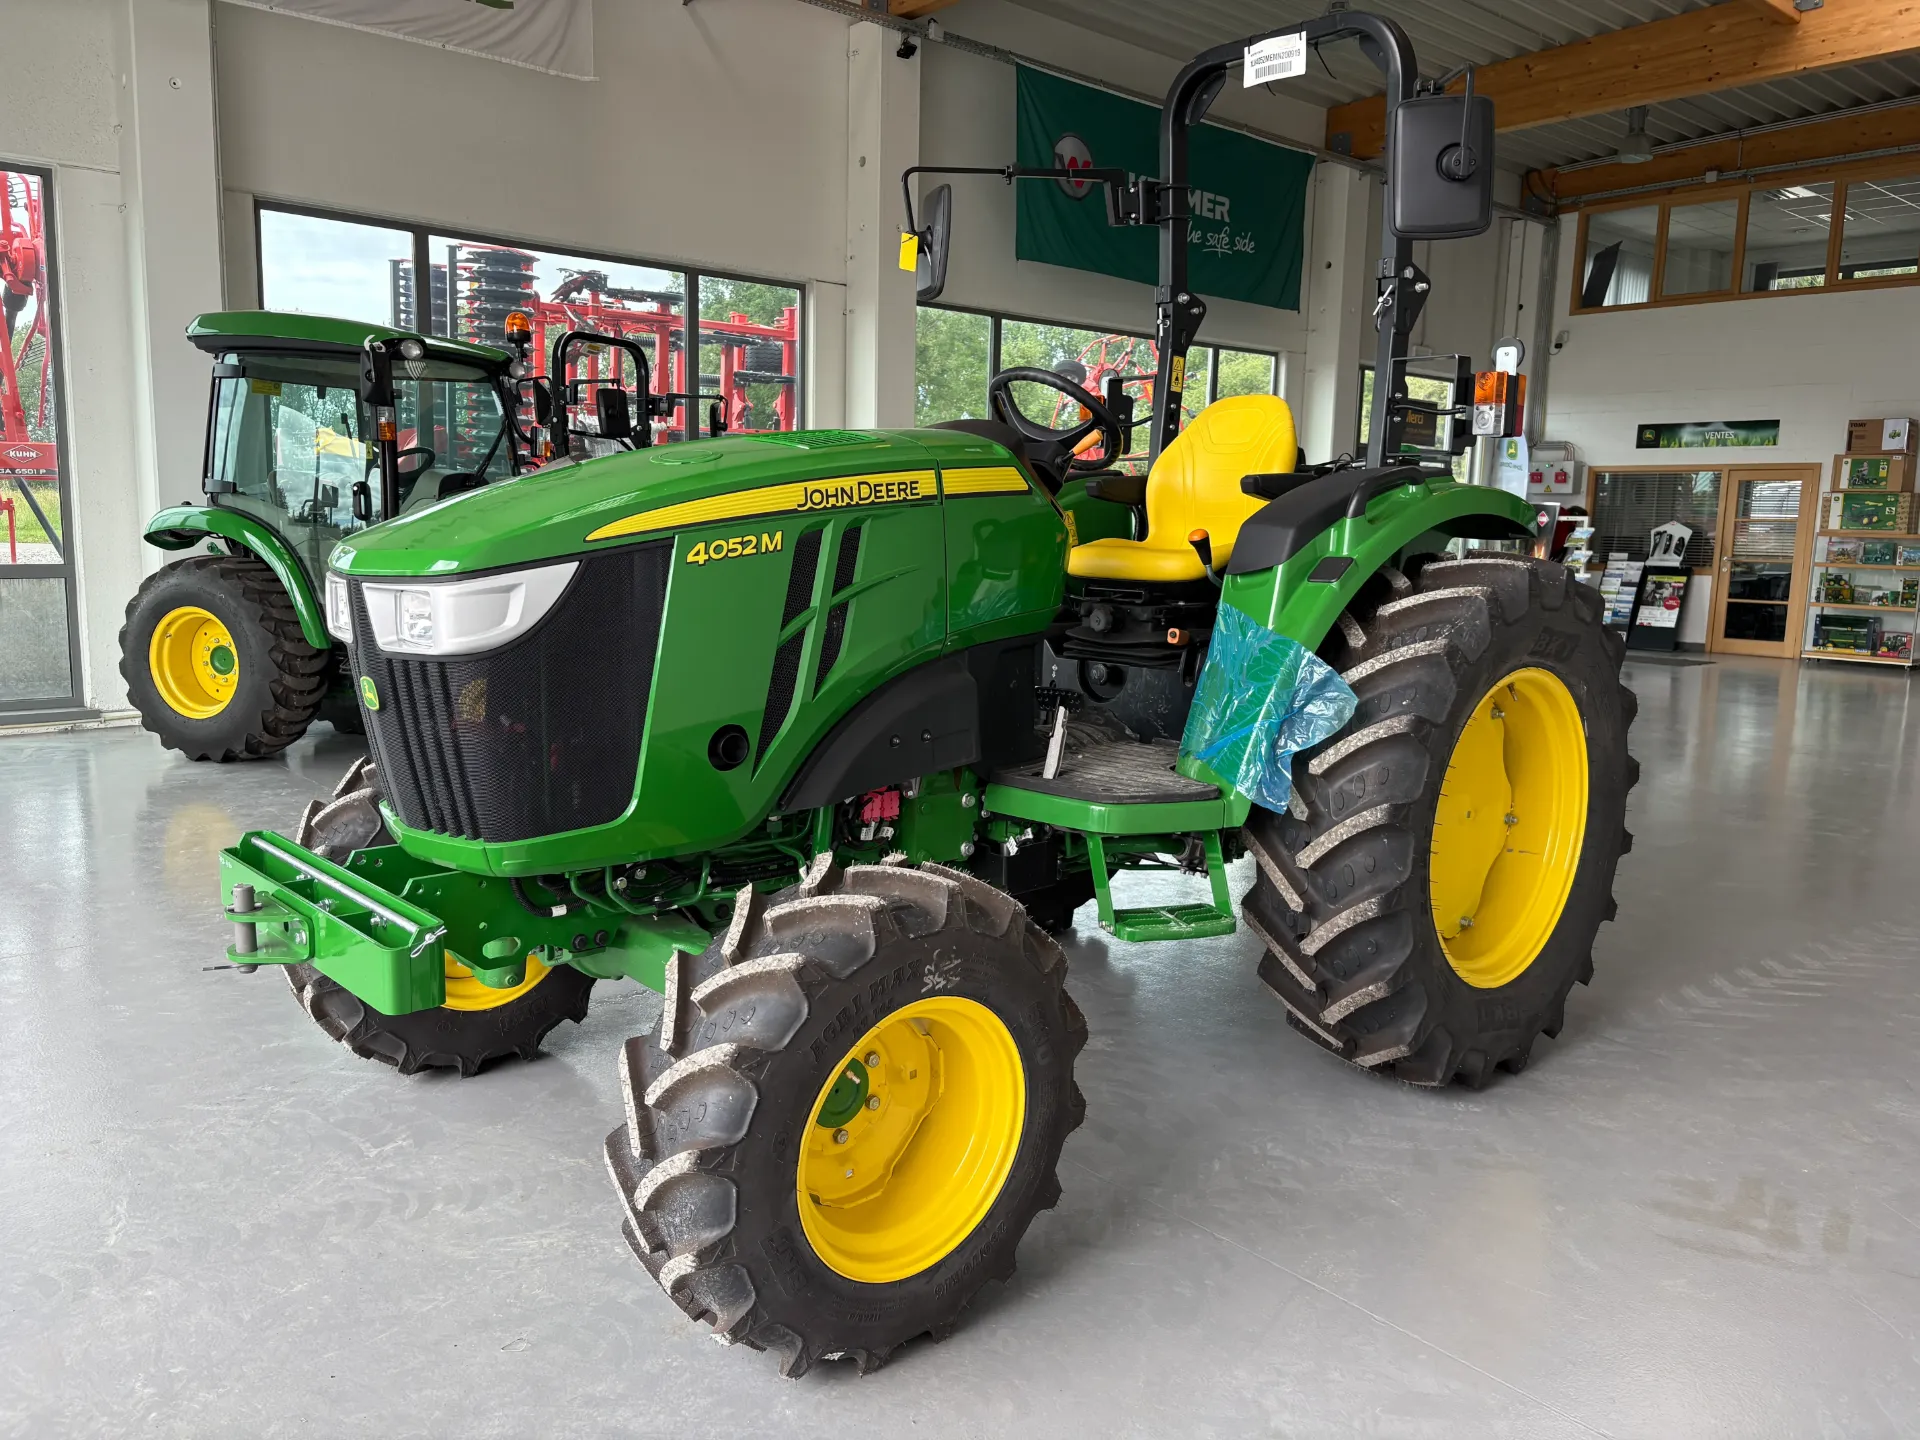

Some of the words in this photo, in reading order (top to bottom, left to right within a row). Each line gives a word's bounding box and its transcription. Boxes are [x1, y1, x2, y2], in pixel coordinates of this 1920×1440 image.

[1206, 226, 1231, 257] safe
[1233, 231, 1255, 254] side
[1704, 431, 1735, 440] VENTES
[9, 450, 37, 458] KUHN
[797, 486, 854, 509] JOHN
[857, 480, 920, 500] DEERE
[686, 534, 758, 566] 4052
[760, 530, 783, 553] M
